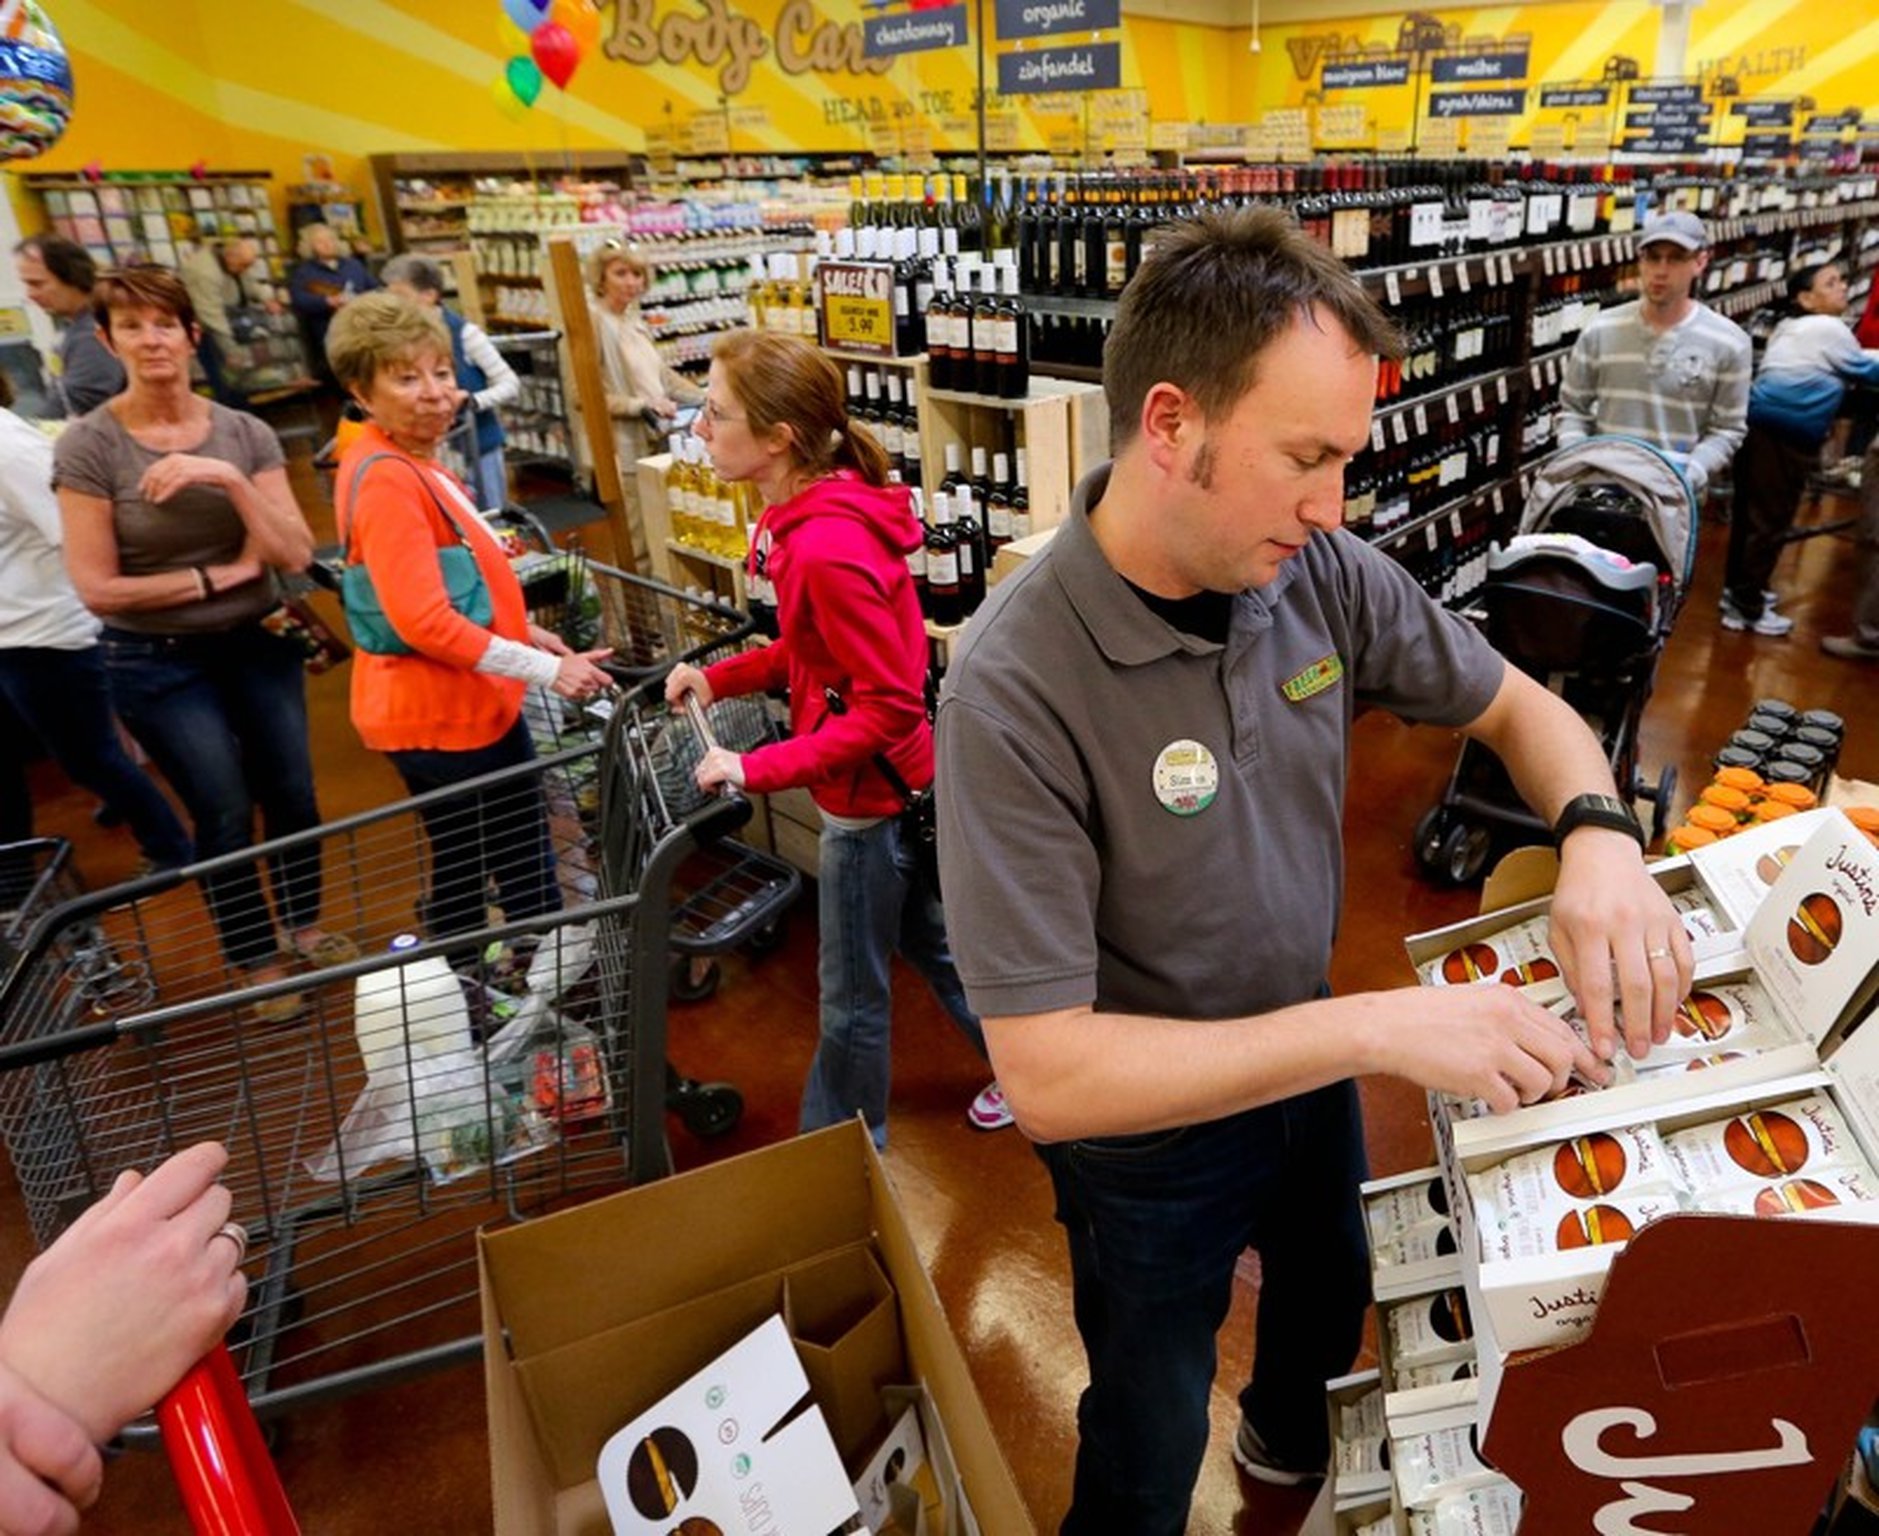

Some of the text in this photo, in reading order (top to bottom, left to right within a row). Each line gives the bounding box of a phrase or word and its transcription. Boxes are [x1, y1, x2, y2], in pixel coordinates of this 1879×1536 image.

[1022, 0, 1085, 28] organic
[603, 0, 767, 93] Body
[876, 20, 954, 46] chardonnay
[1018, 53, 1095, 82] zinfandel
